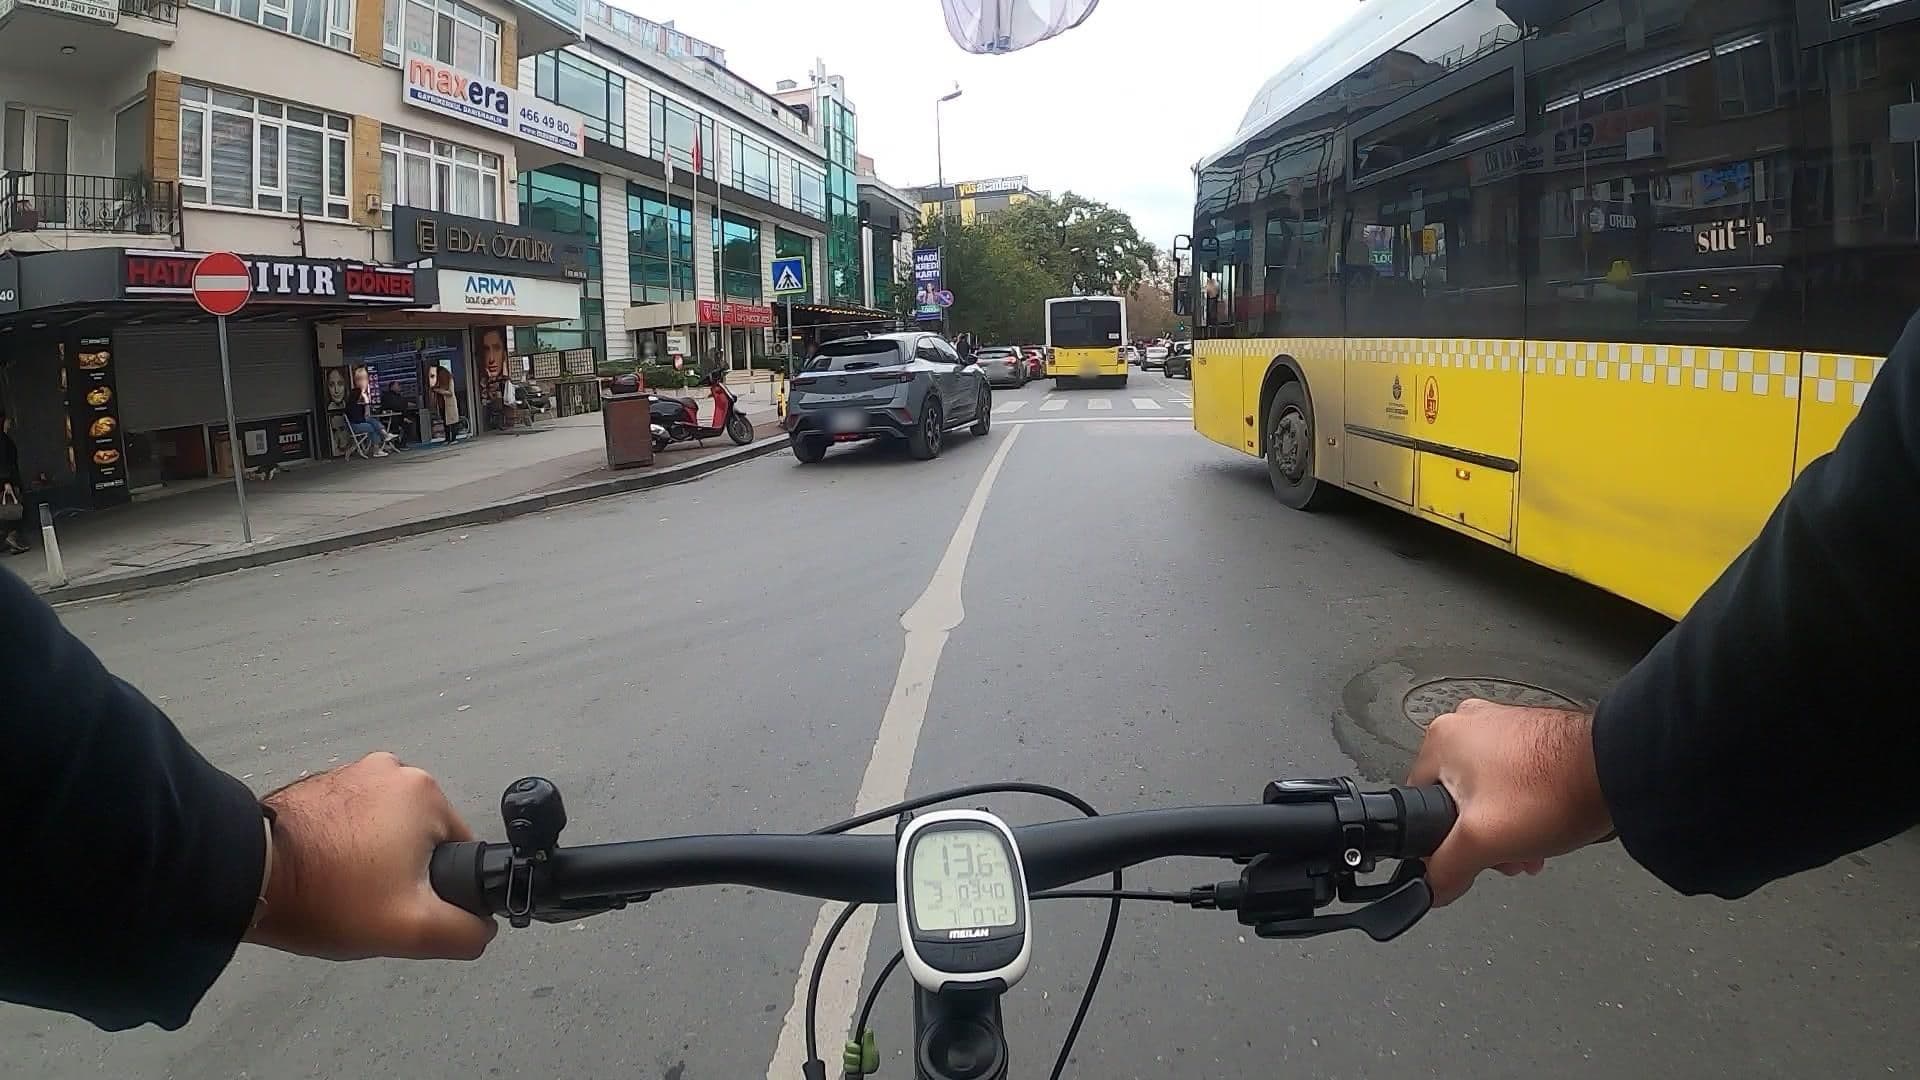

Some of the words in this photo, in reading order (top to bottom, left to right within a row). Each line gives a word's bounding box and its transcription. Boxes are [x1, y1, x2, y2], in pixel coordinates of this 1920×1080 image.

[409, 58, 508, 114] maxera
[520, 107, 540, 123] 466
[542, 115, 555, 129] 49
[557, 119, 569, 134] 80
[446, 225, 488, 255] EDA
[491, 227, 555, 264] ÖZTÜRK
[246, 260, 336, 295] ITIR
[346, 266, 413, 296] DÖNER
[465, 275, 516, 296] ARMA
[949, 928, 989, 939] MEILAN
